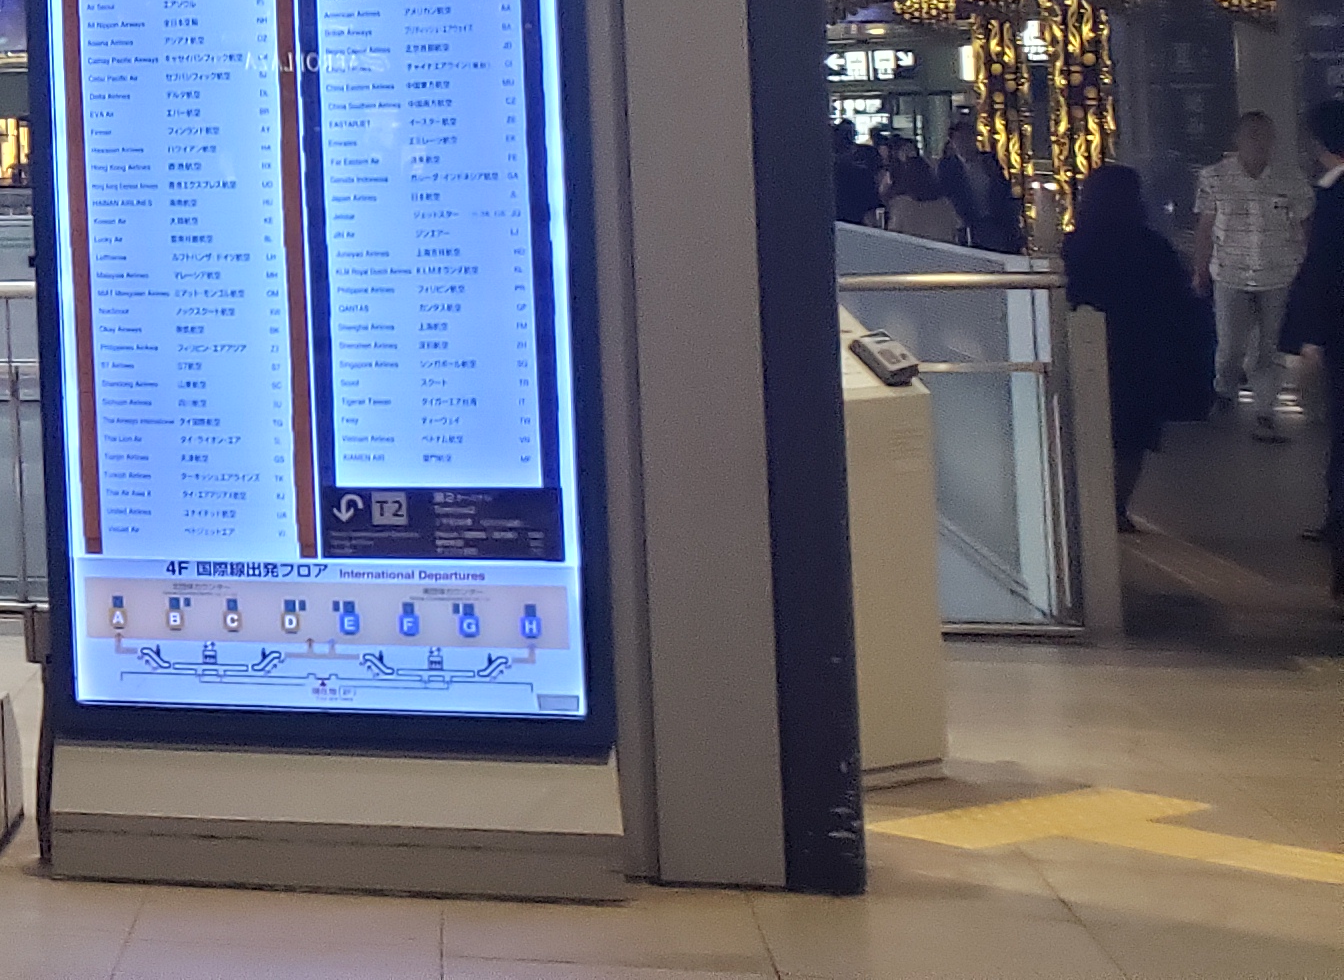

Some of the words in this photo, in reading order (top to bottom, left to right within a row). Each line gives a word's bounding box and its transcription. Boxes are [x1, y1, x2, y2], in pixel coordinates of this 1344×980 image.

[374, 499, 405, 518] T2
[165, 561, 190, 576] 4F
[196, 561, 328, 579] 国際線出発フロア
[339, 569, 415, 582] International
[418, 569, 486, 582] Departures
